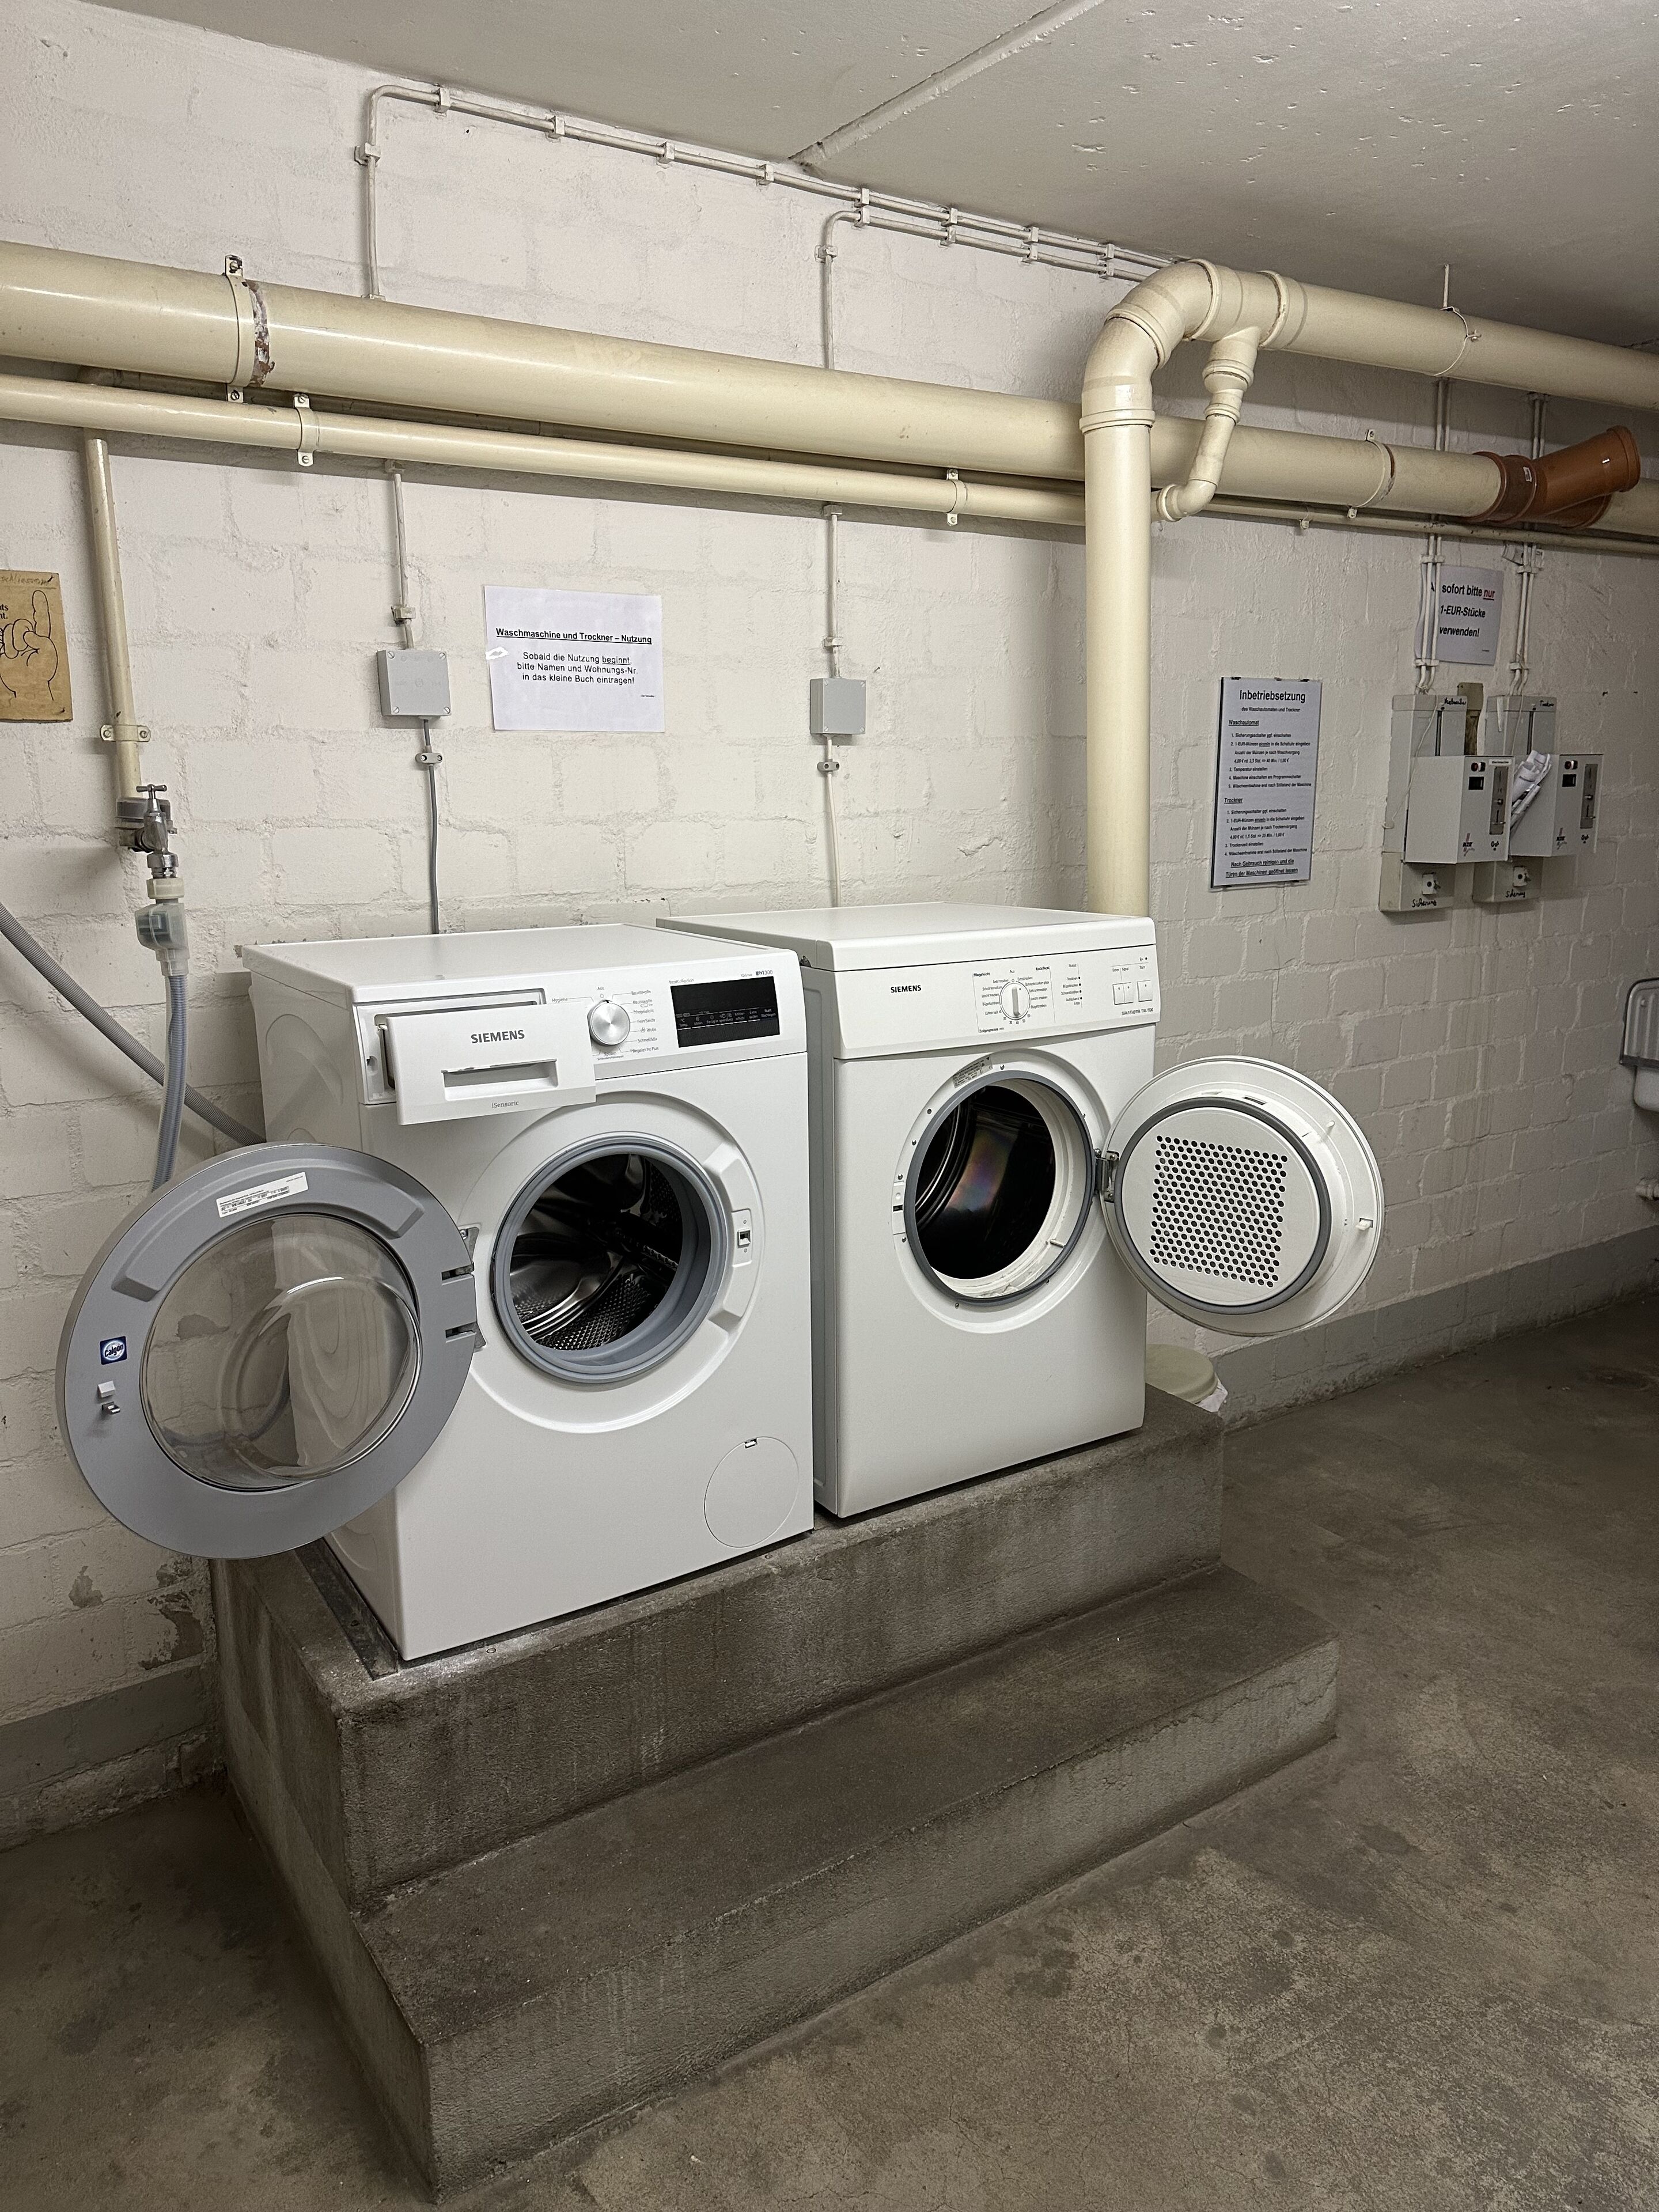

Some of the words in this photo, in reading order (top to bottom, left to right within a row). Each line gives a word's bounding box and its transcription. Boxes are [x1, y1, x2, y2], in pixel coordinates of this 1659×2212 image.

[1442, 584, 1465, 594] sofort
[1467, 585, 1482, 596] bitte
[1484, 589, 1495, 599] nur
[1440, 605, 1486, 618] 1-EUR-Stücke
[496, 628, 560, 639] Waschmaschine
[579, 632, 613, 641] Trockner
[621, 634, 652, 644] Nutzung
[1440, 627, 1480, 637] verwenden!
[523, 652, 551, 661] Sobald
[553, 653, 565, 662] die
[567, 654, 599, 664] Nutzung
[602, 655, 632, 665] beginnt,
[517, 662, 535, 671] bitte
[537, 664, 565, 672] Namen
[585, 665, 638, 675] Wohnungs-Nr.
[522, 673, 529, 681] in
[549, 674, 572, 682] kleine
[575, 675, 594, 683] Buch
[597, 676, 635, 685] eintragen!
[1240, 690, 1306, 703] Inbetriebsetzung
[891, 984, 922, 993] SIEMENS
[471, 1029, 525, 1044] SIEMENS
[105, 1344, 124, 1357] Calgon
